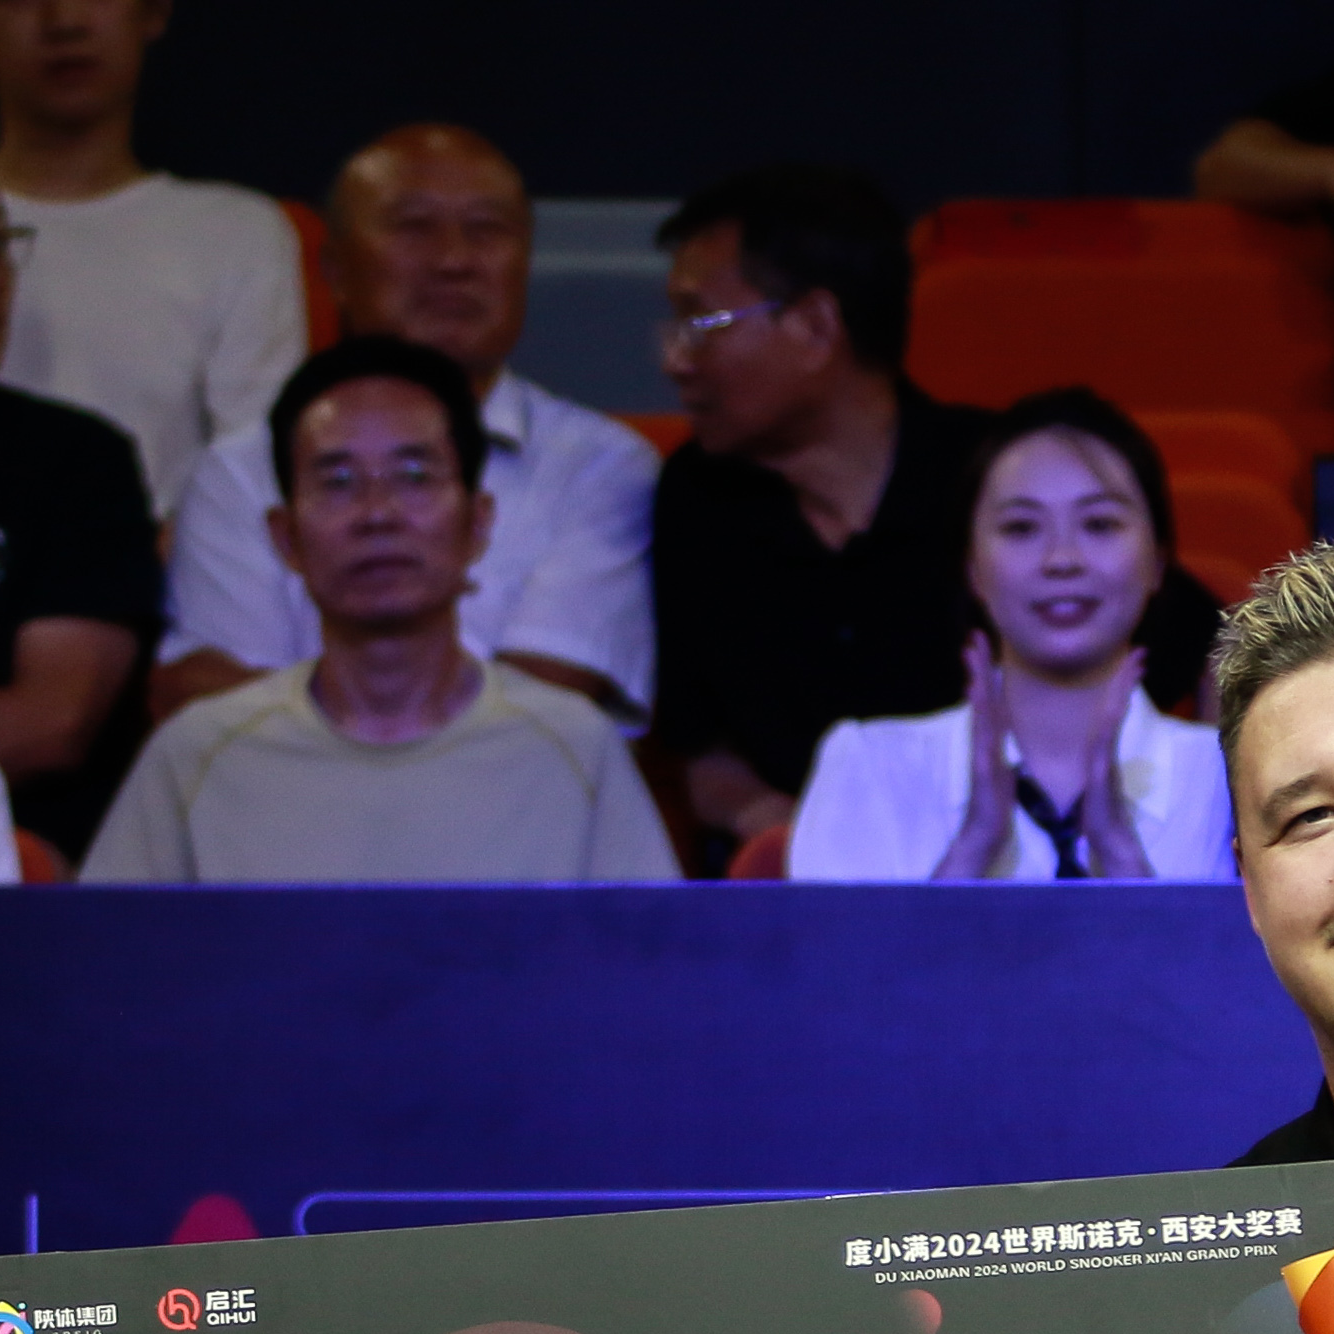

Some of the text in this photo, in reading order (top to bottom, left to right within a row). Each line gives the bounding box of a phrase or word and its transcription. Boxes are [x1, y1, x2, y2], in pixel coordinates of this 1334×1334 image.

[845, 1206, 1303, 1267] 度小满2024世界斯诺克·西安大奖赛
[875, 1244, 1278, 1284] DU XIAOMAN 2024 WORLD SNOOKER XI'AN GRAND PRIX
[205, 1288, 256, 1312] 启汇
[33, 1304, 117, 1330] 陕体集团
[206, 1310, 257, 1327] QIHUI
